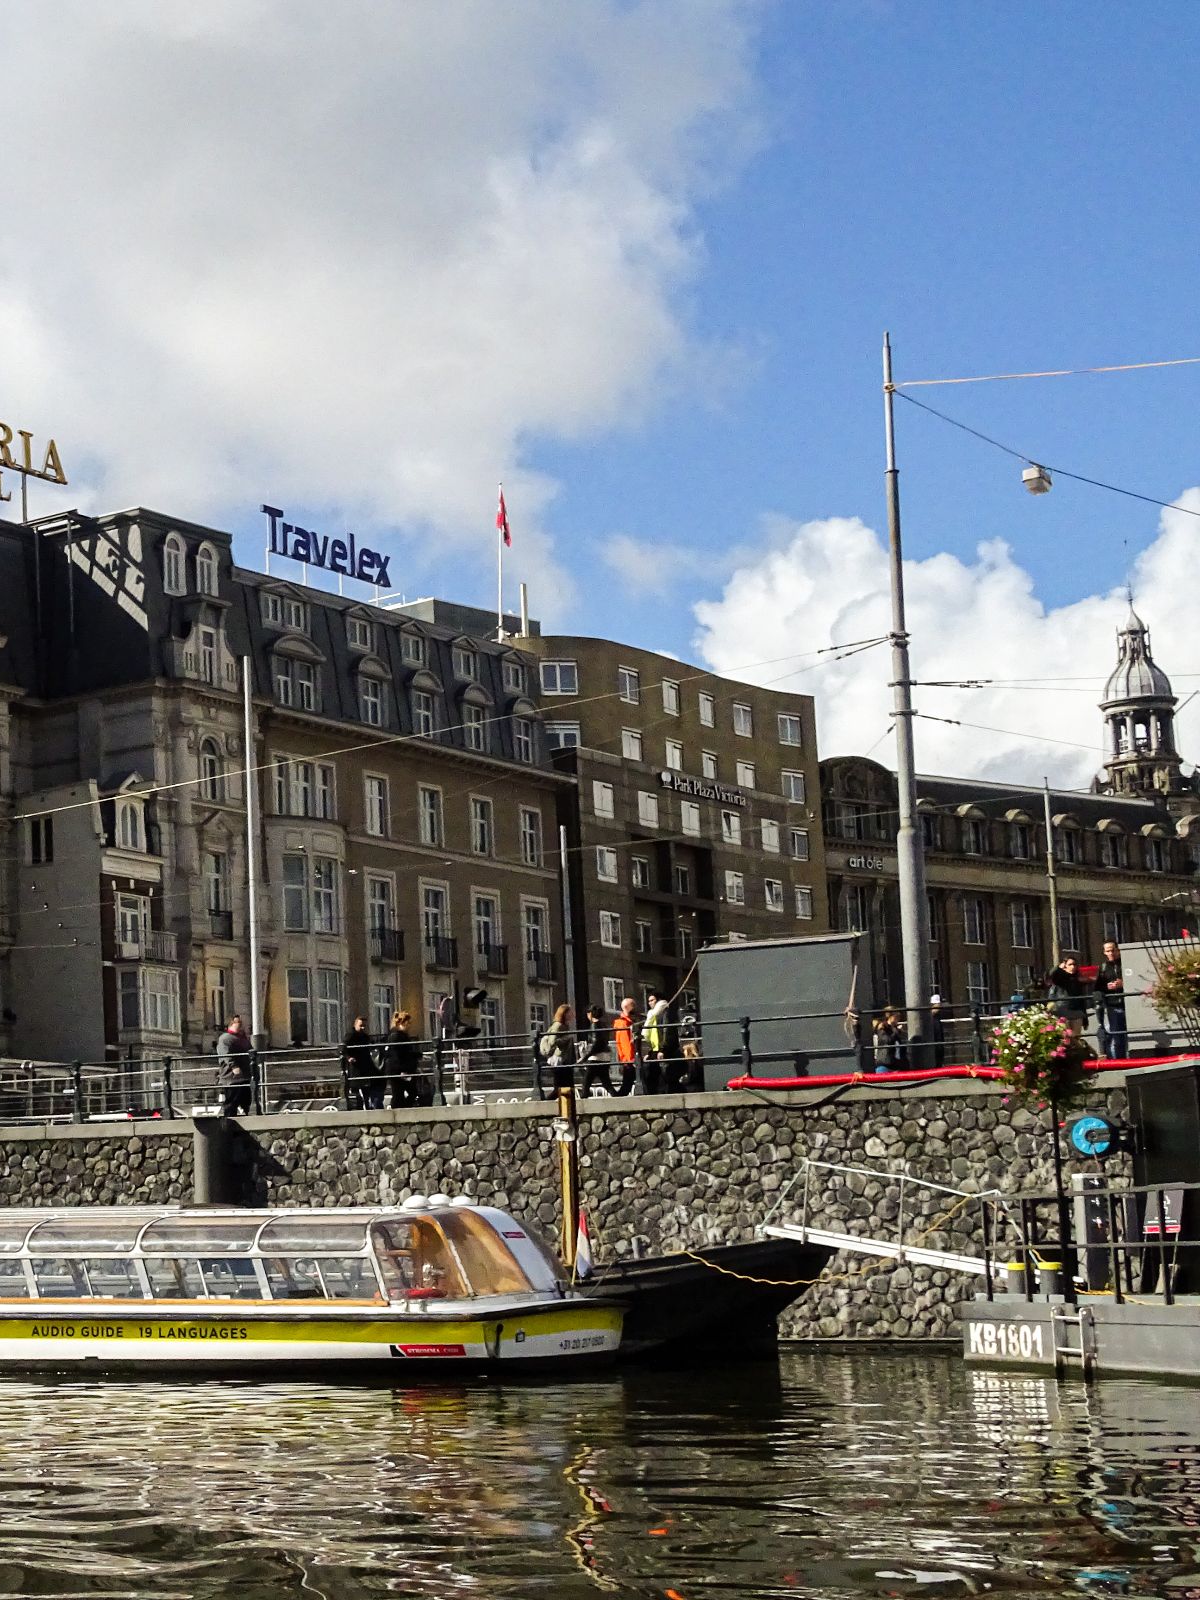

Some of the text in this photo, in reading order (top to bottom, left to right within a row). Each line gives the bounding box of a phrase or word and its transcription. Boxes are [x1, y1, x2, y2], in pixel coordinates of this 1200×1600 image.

[259, 503, 392, 588] Travelex
[674, 775, 746, 807] Park Plaza Victoria
[849, 855, 865, 868] art
[31, 1325, 248, 1339] AUDIO GUIDE 19 LANGUAGES
